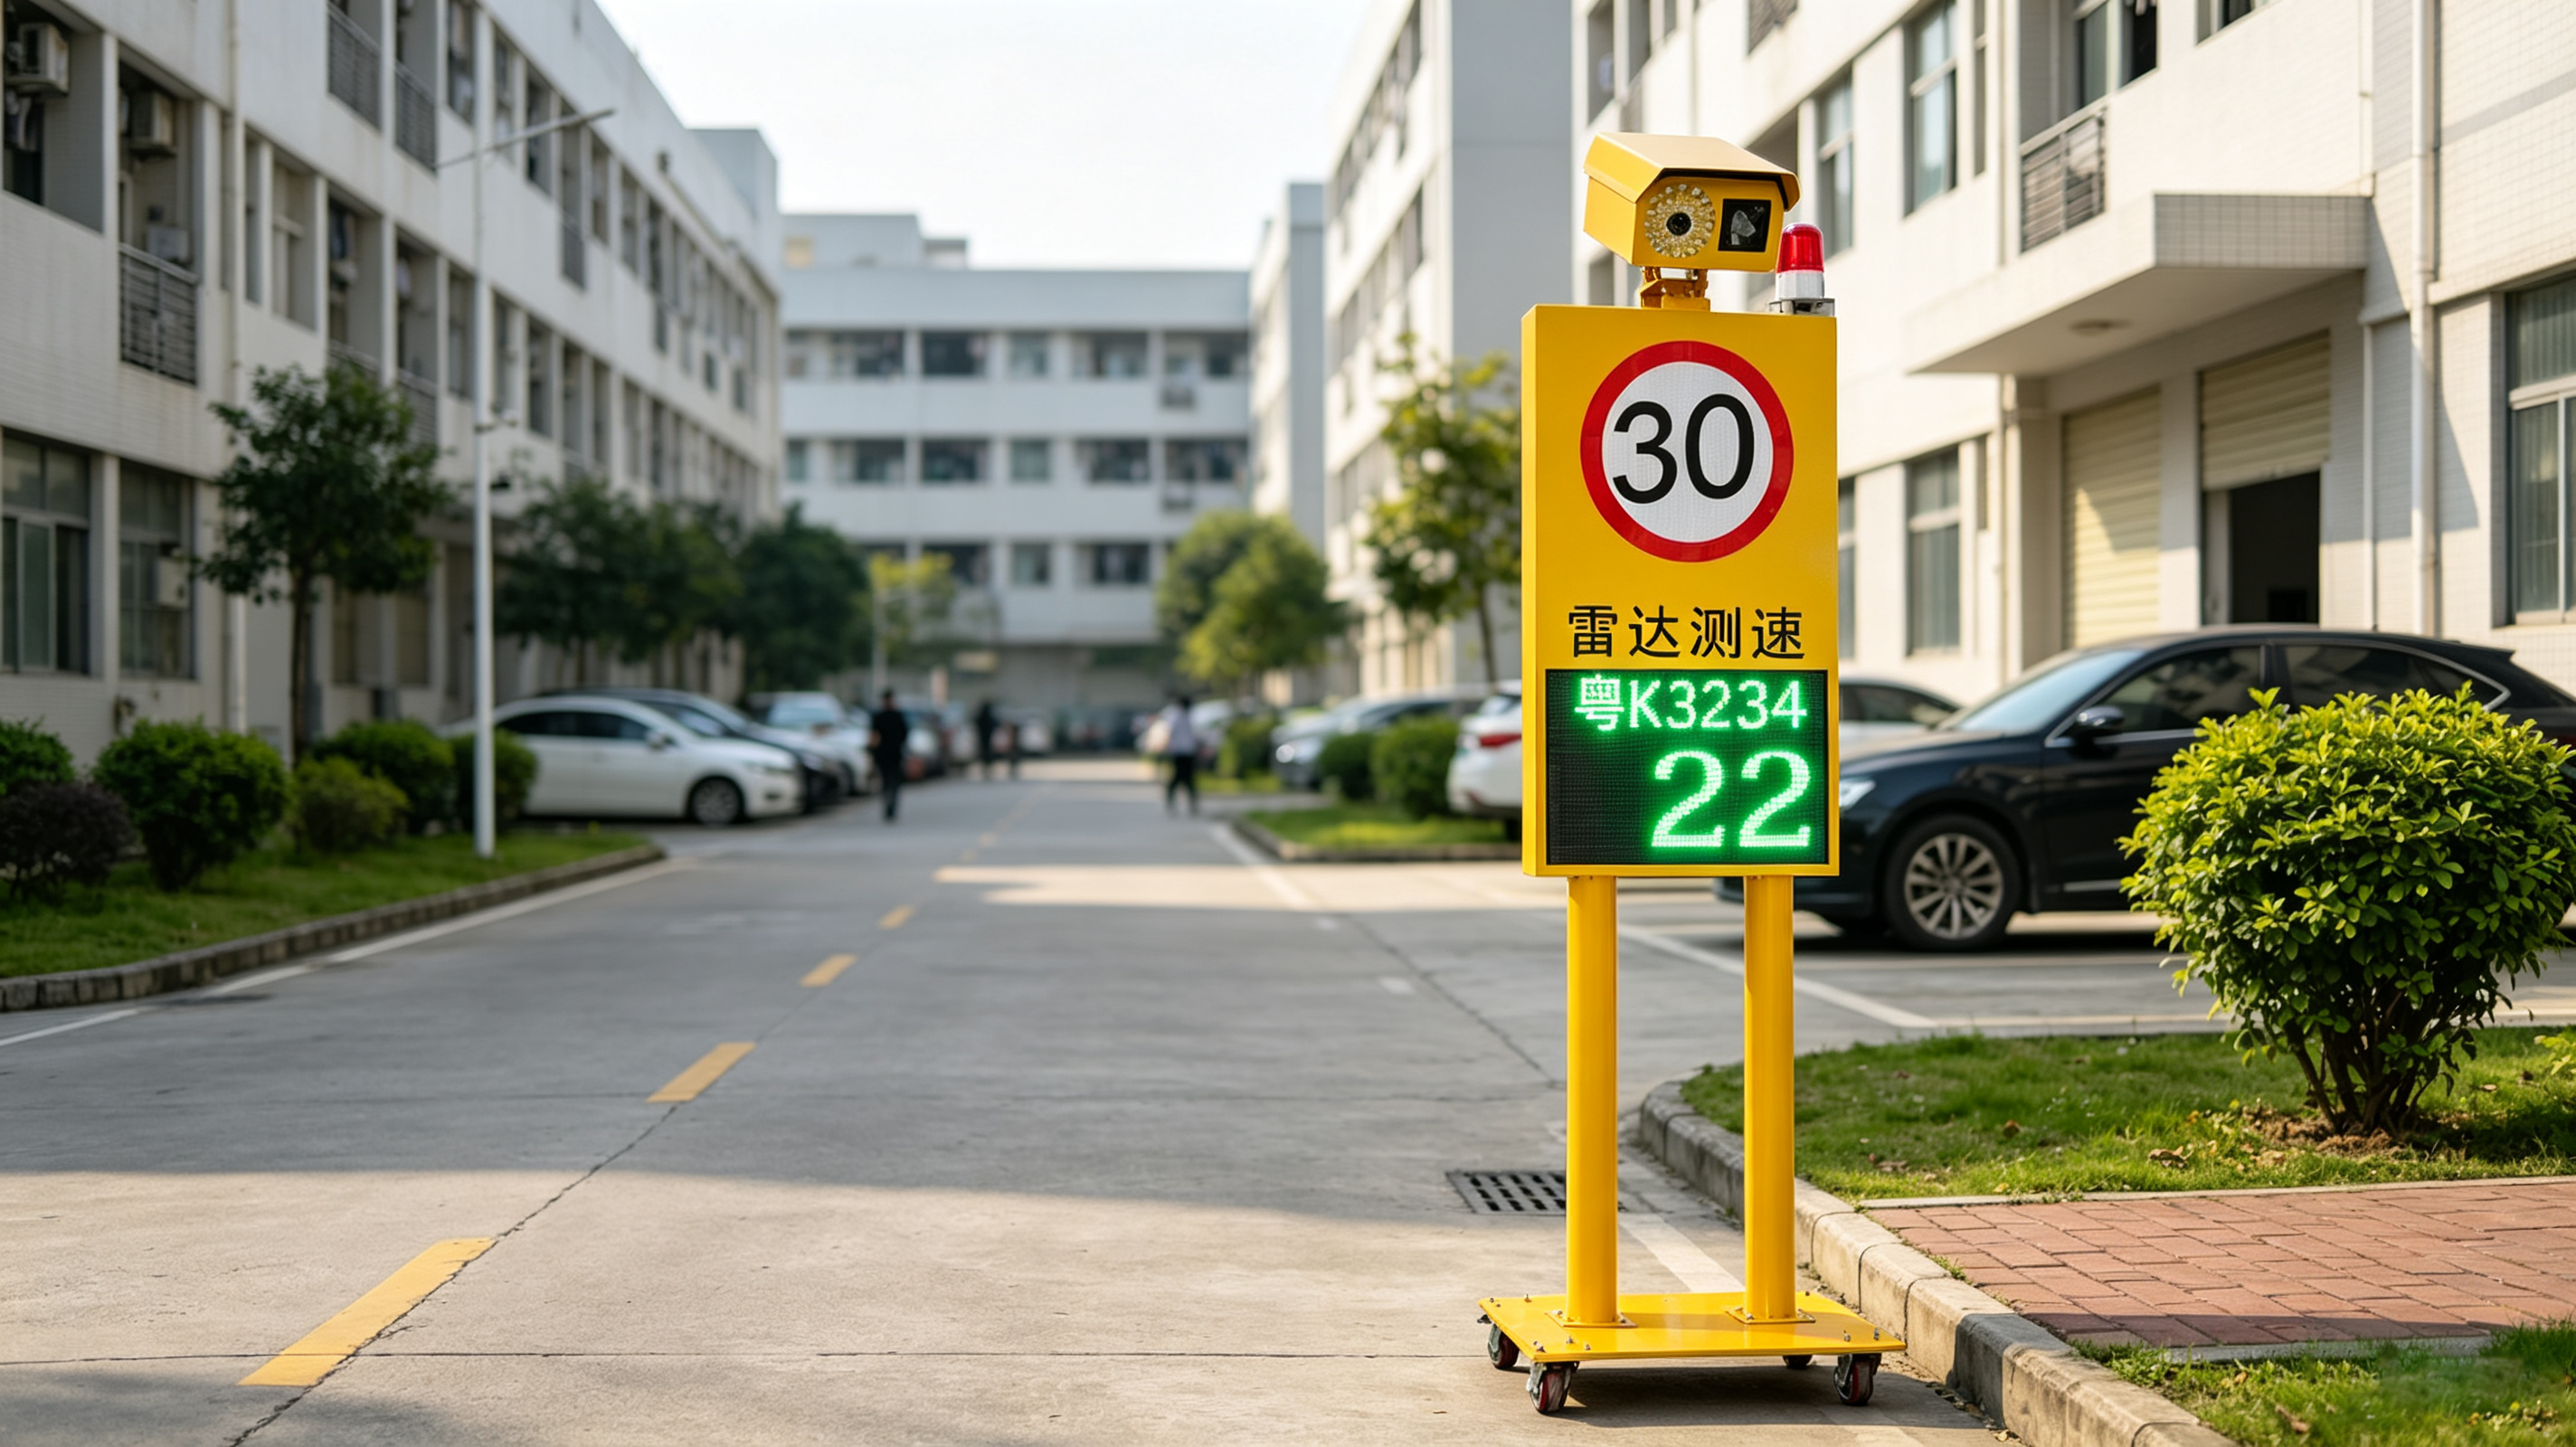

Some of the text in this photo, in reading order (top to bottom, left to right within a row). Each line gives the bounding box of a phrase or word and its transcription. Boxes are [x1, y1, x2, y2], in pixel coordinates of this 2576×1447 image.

[1613, 393, 1755, 505] 30
[1568, 605, 1805, 659] 雷达测速
[1575, 674, 1807, 731] 粤K3234
[1652, 751, 1811, 847] 22
